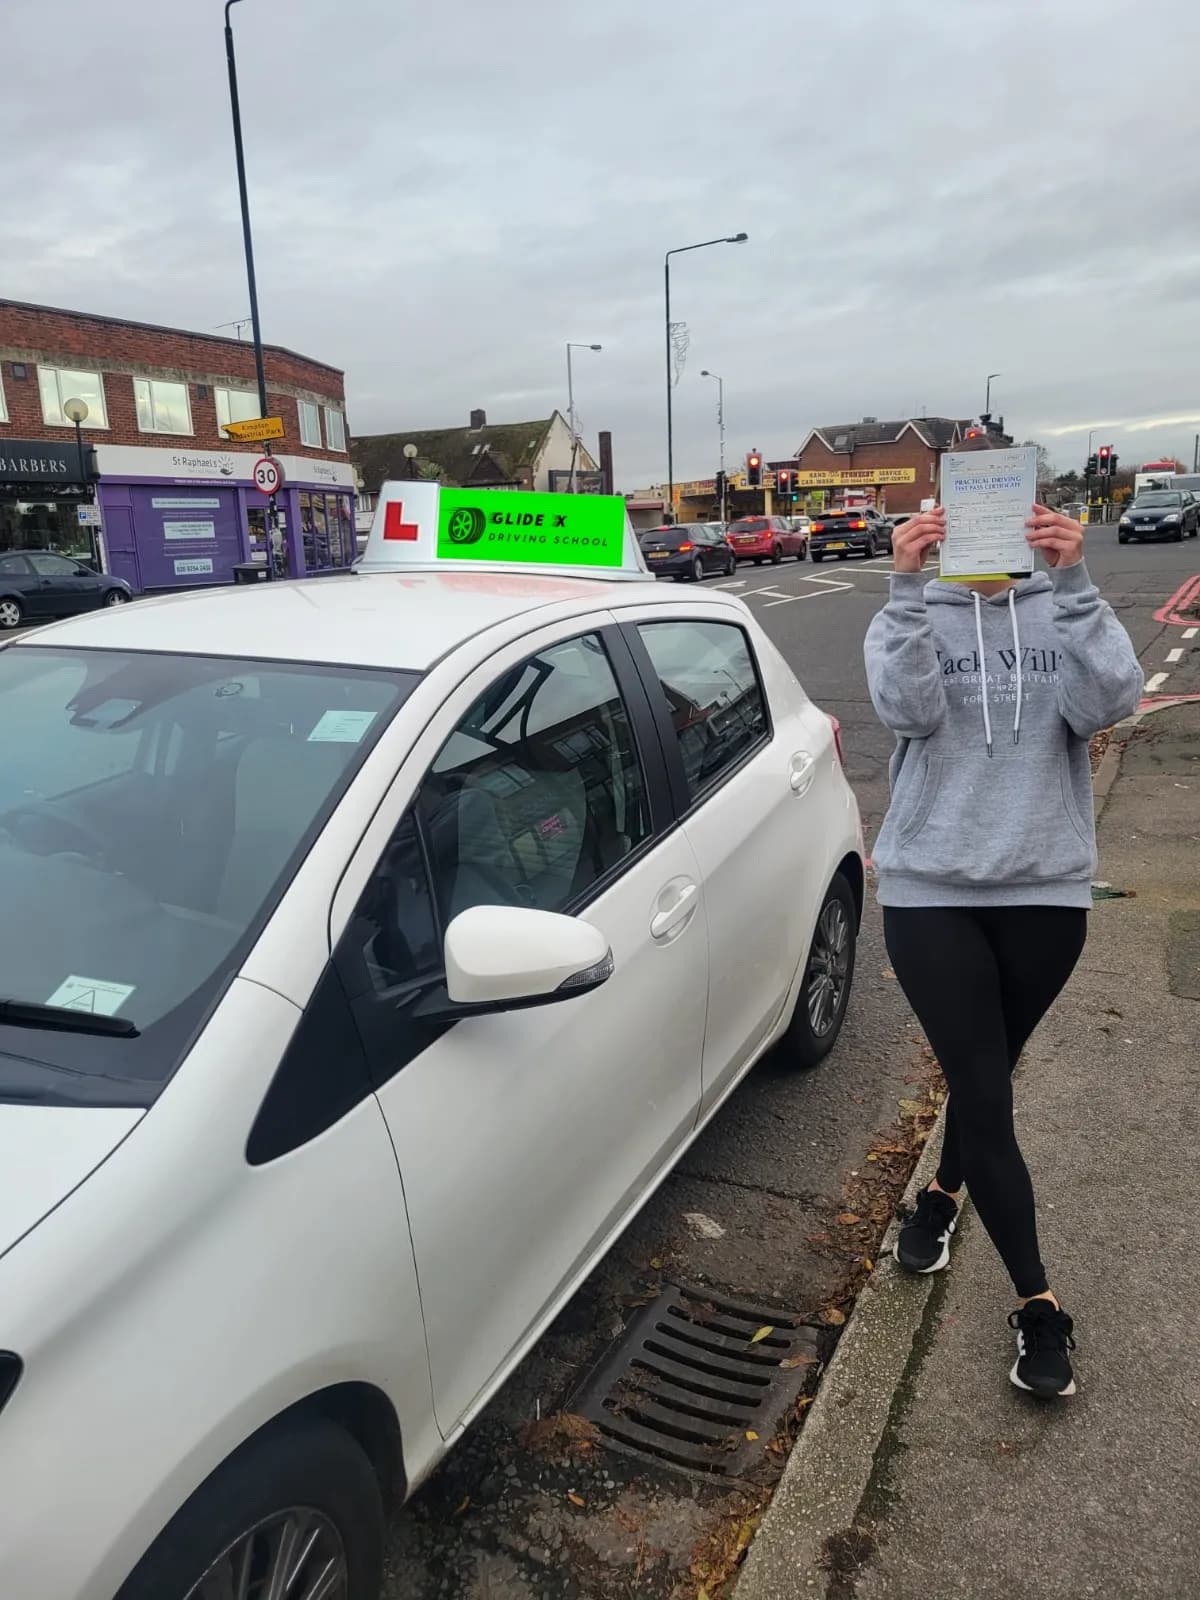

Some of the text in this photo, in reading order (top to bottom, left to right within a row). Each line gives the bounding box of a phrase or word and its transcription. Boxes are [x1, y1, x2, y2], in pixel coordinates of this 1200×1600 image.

[0, 458, 67, 473] BARBERS
[172, 456, 181, 466] St
[256, 469, 276, 484] 30
[954, 475, 1022, 486] PRACTICAL DRIVING
[969, 483, 984, 491] PASS
[984, 481, 1021, 490] CERTIFICATE
[384, 502, 418, 540] L
[492, 512, 568, 527] GLIDE X
[488, 532, 608, 547] DRIVING SCHOOL
[996, 647, 1063, 673] Will
